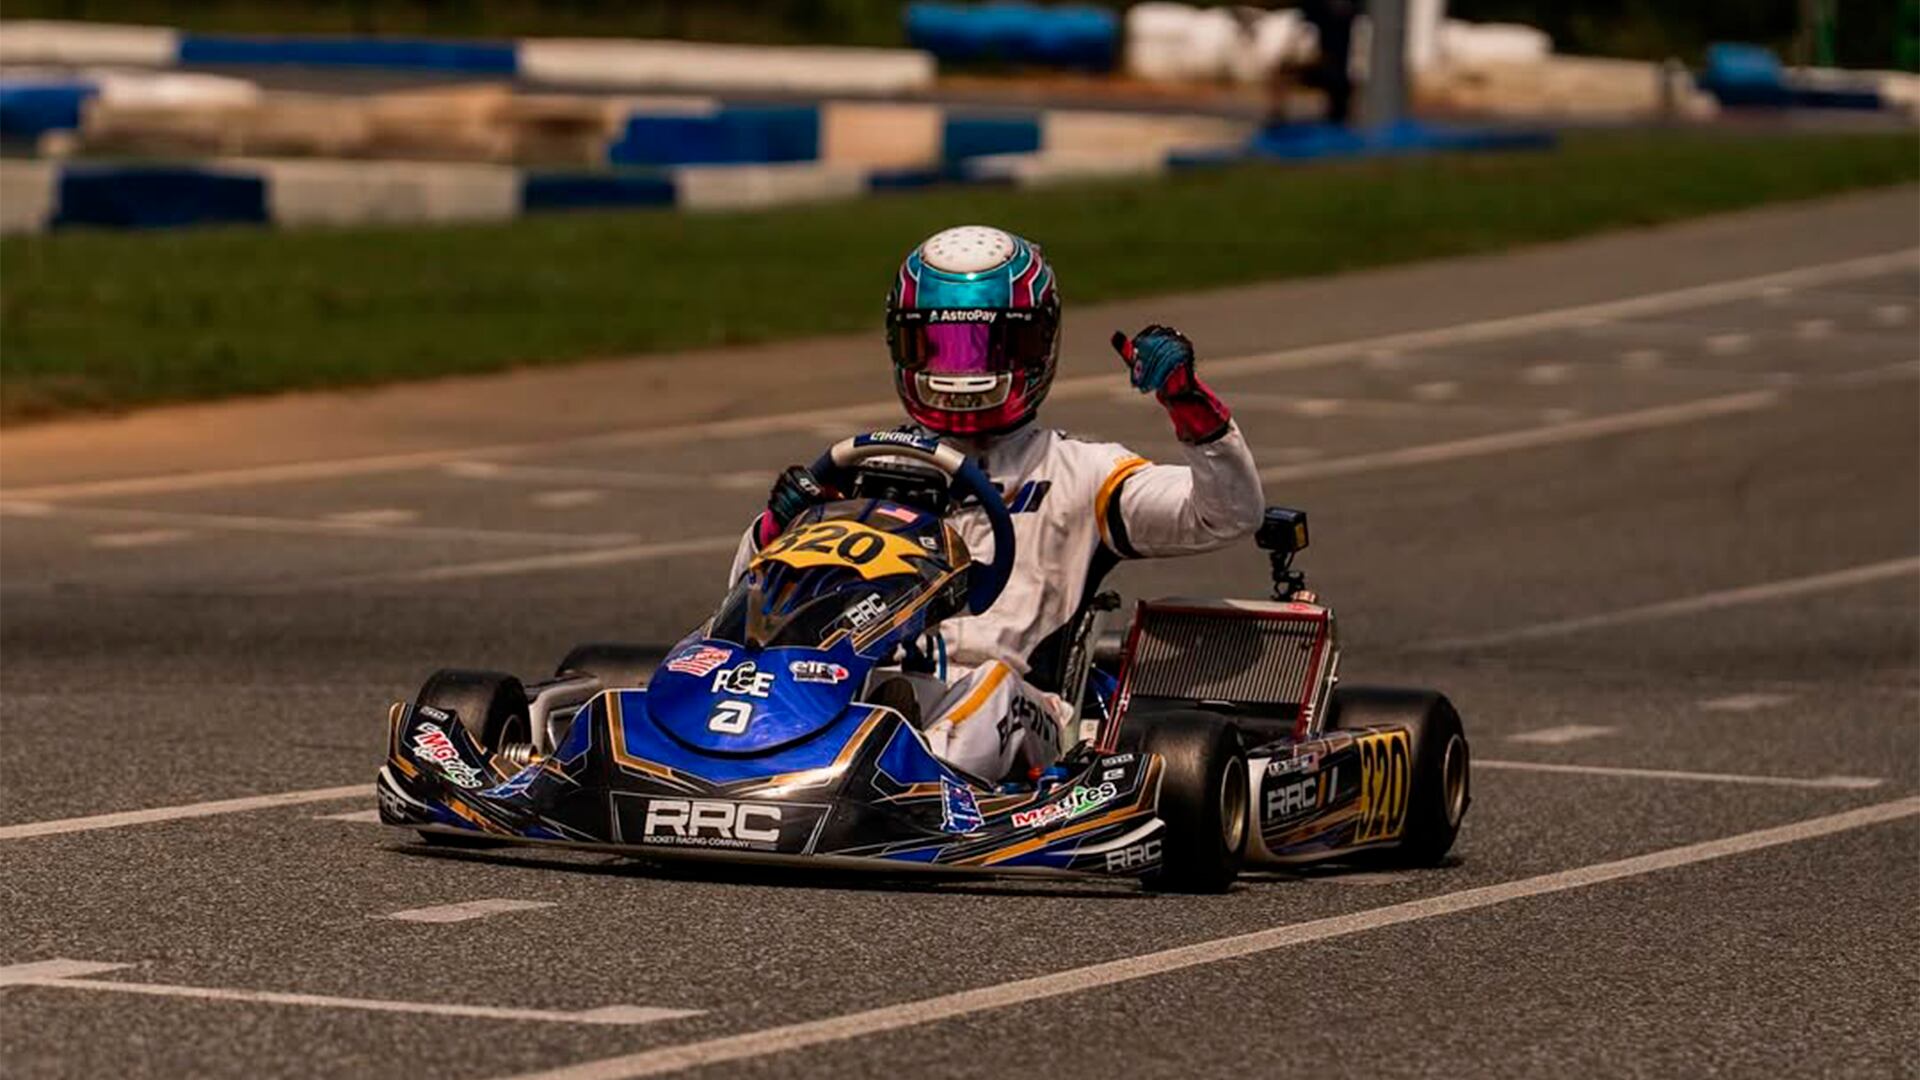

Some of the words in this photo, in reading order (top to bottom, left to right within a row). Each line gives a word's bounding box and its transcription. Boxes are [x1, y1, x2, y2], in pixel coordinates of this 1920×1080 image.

[941, 309, 998, 323] AstroPay
[1267, 777, 1316, 819] RRC
[1361, 735, 1406, 837] 320
[644, 799, 782, 843] RRC
[643, 836, 675, 845] ROCKET
[675, 837, 708, 846] RACING
[709, 838, 750, 848] COMPANY
[1105, 839, 1163, 871] RRC
